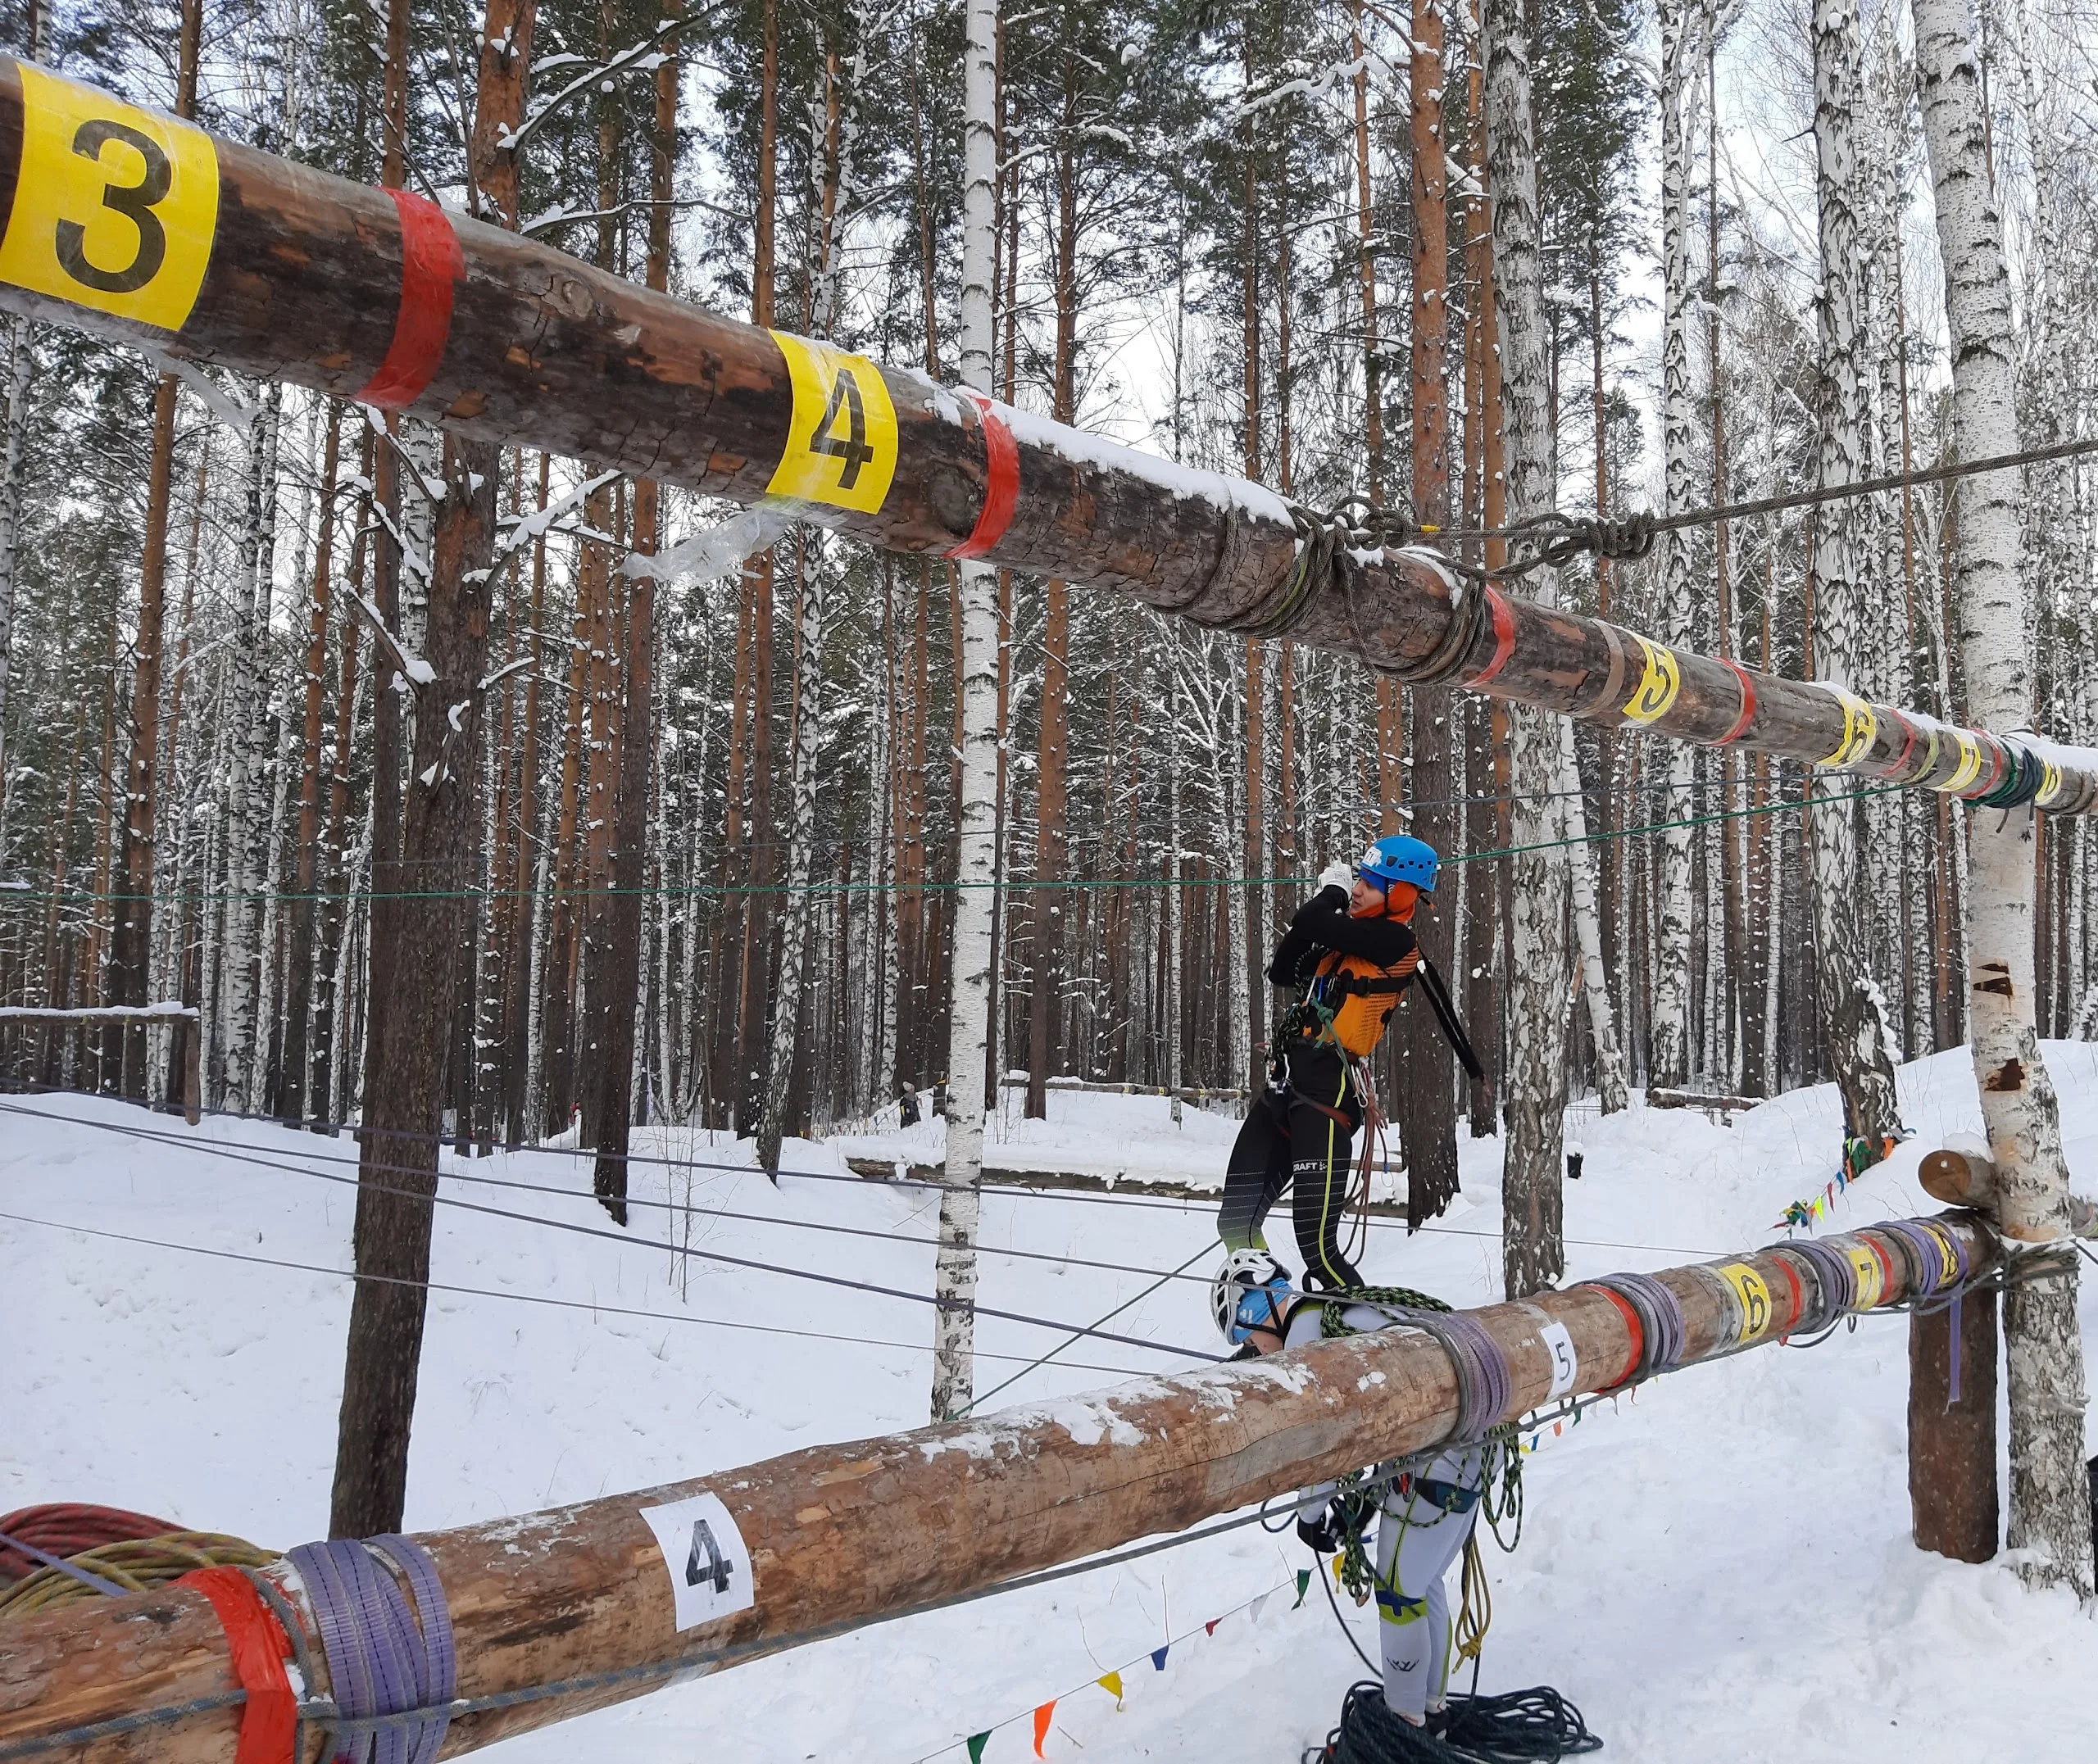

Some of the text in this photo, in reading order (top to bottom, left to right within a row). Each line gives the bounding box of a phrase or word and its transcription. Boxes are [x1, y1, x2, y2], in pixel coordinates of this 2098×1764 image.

[55, 119, 172, 292] 3
[809, 368, 874, 490] 4
[1641, 643, 1671, 713] 5
[1838, 709, 1870, 764] 6
[1741, 1275, 1765, 1334] 6
[1860, 1262, 1873, 1305] 7
[1555, 1341, 1570, 1381] 5
[685, 1518, 734, 1594] 4
